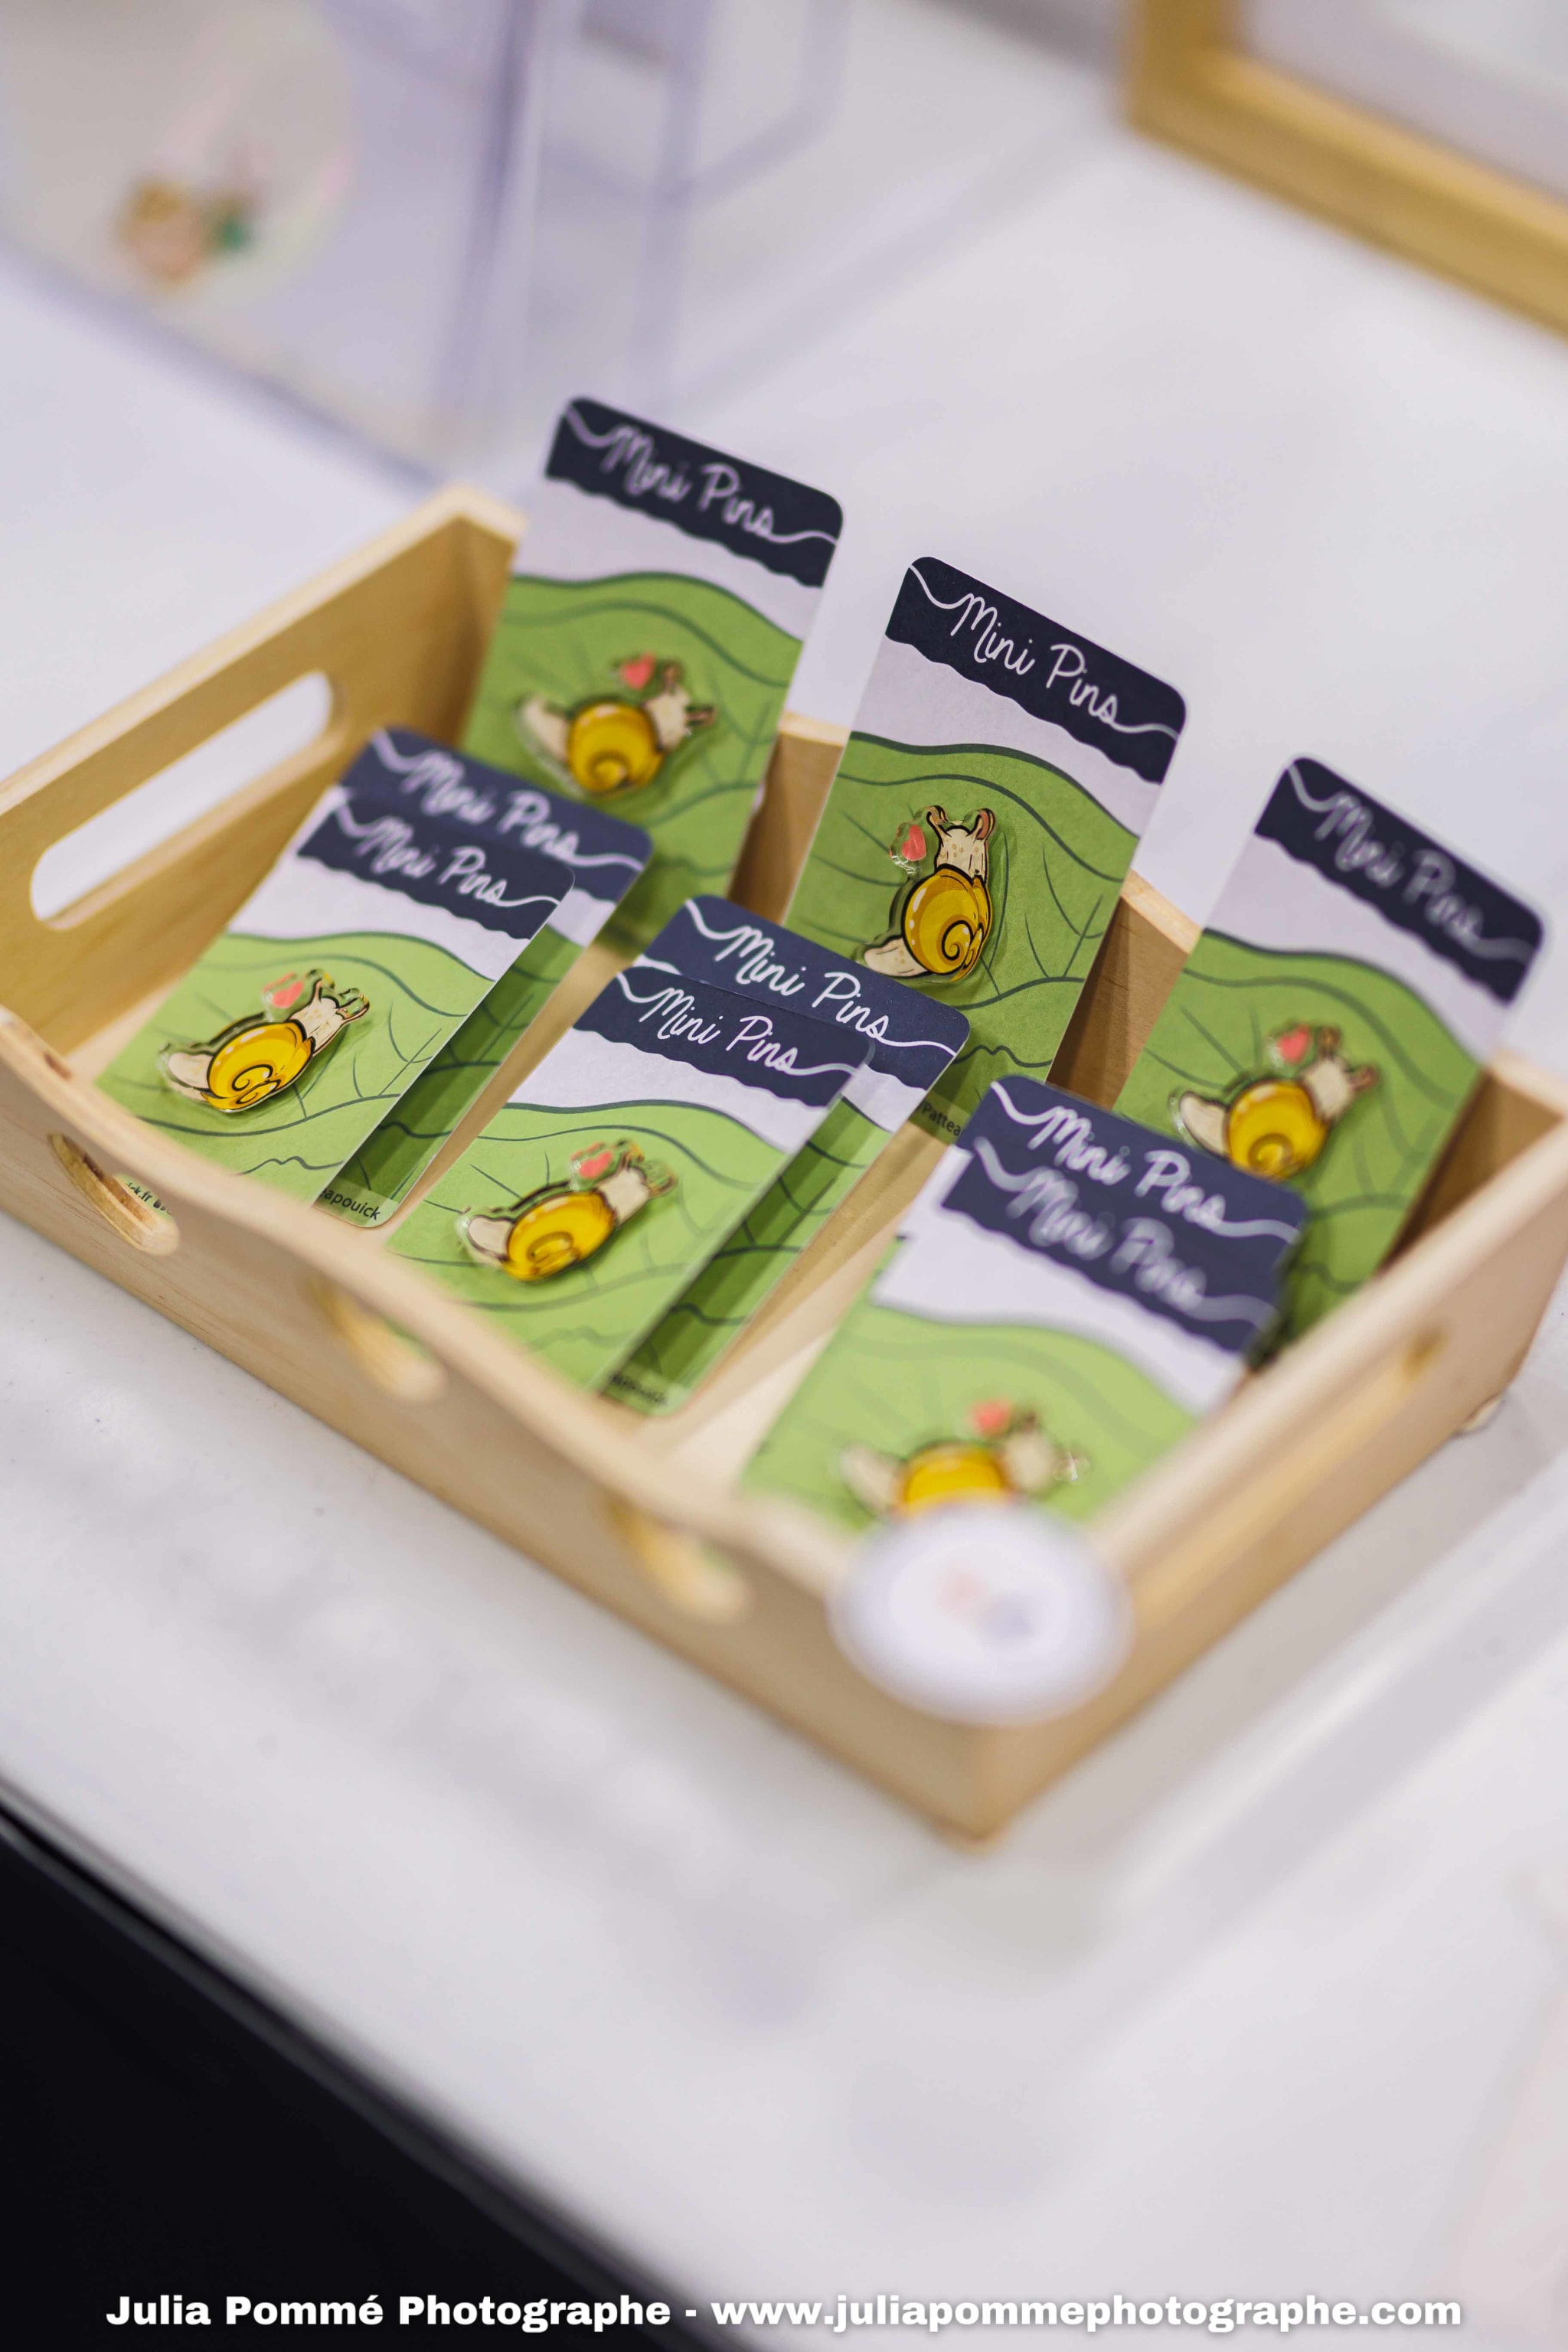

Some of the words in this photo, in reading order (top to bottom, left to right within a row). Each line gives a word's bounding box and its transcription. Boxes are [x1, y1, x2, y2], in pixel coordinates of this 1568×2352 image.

[601, 423, 692, 495] Mini
[698, 462, 775, 536] Pins
[949, 593, 1036, 676] Mini
[1046, 643, 1119, 724] Pins
[354, 815, 437, 879] Mini
[439, 844, 508, 905] Pins
[400, 749, 496, 825] Mini
[498, 789, 580, 862] Pins
[638, 987, 724, 1046] Mini
[725, 1015, 799, 1073] Pins
[714, 925, 805, 997] Mini
[812, 971, 890, 1039] Pins
[320, 1187, 381, 1220] apouick
[1027, 1104, 1138, 1178] Mini
[1134, 1149, 1227, 1230] Pins
